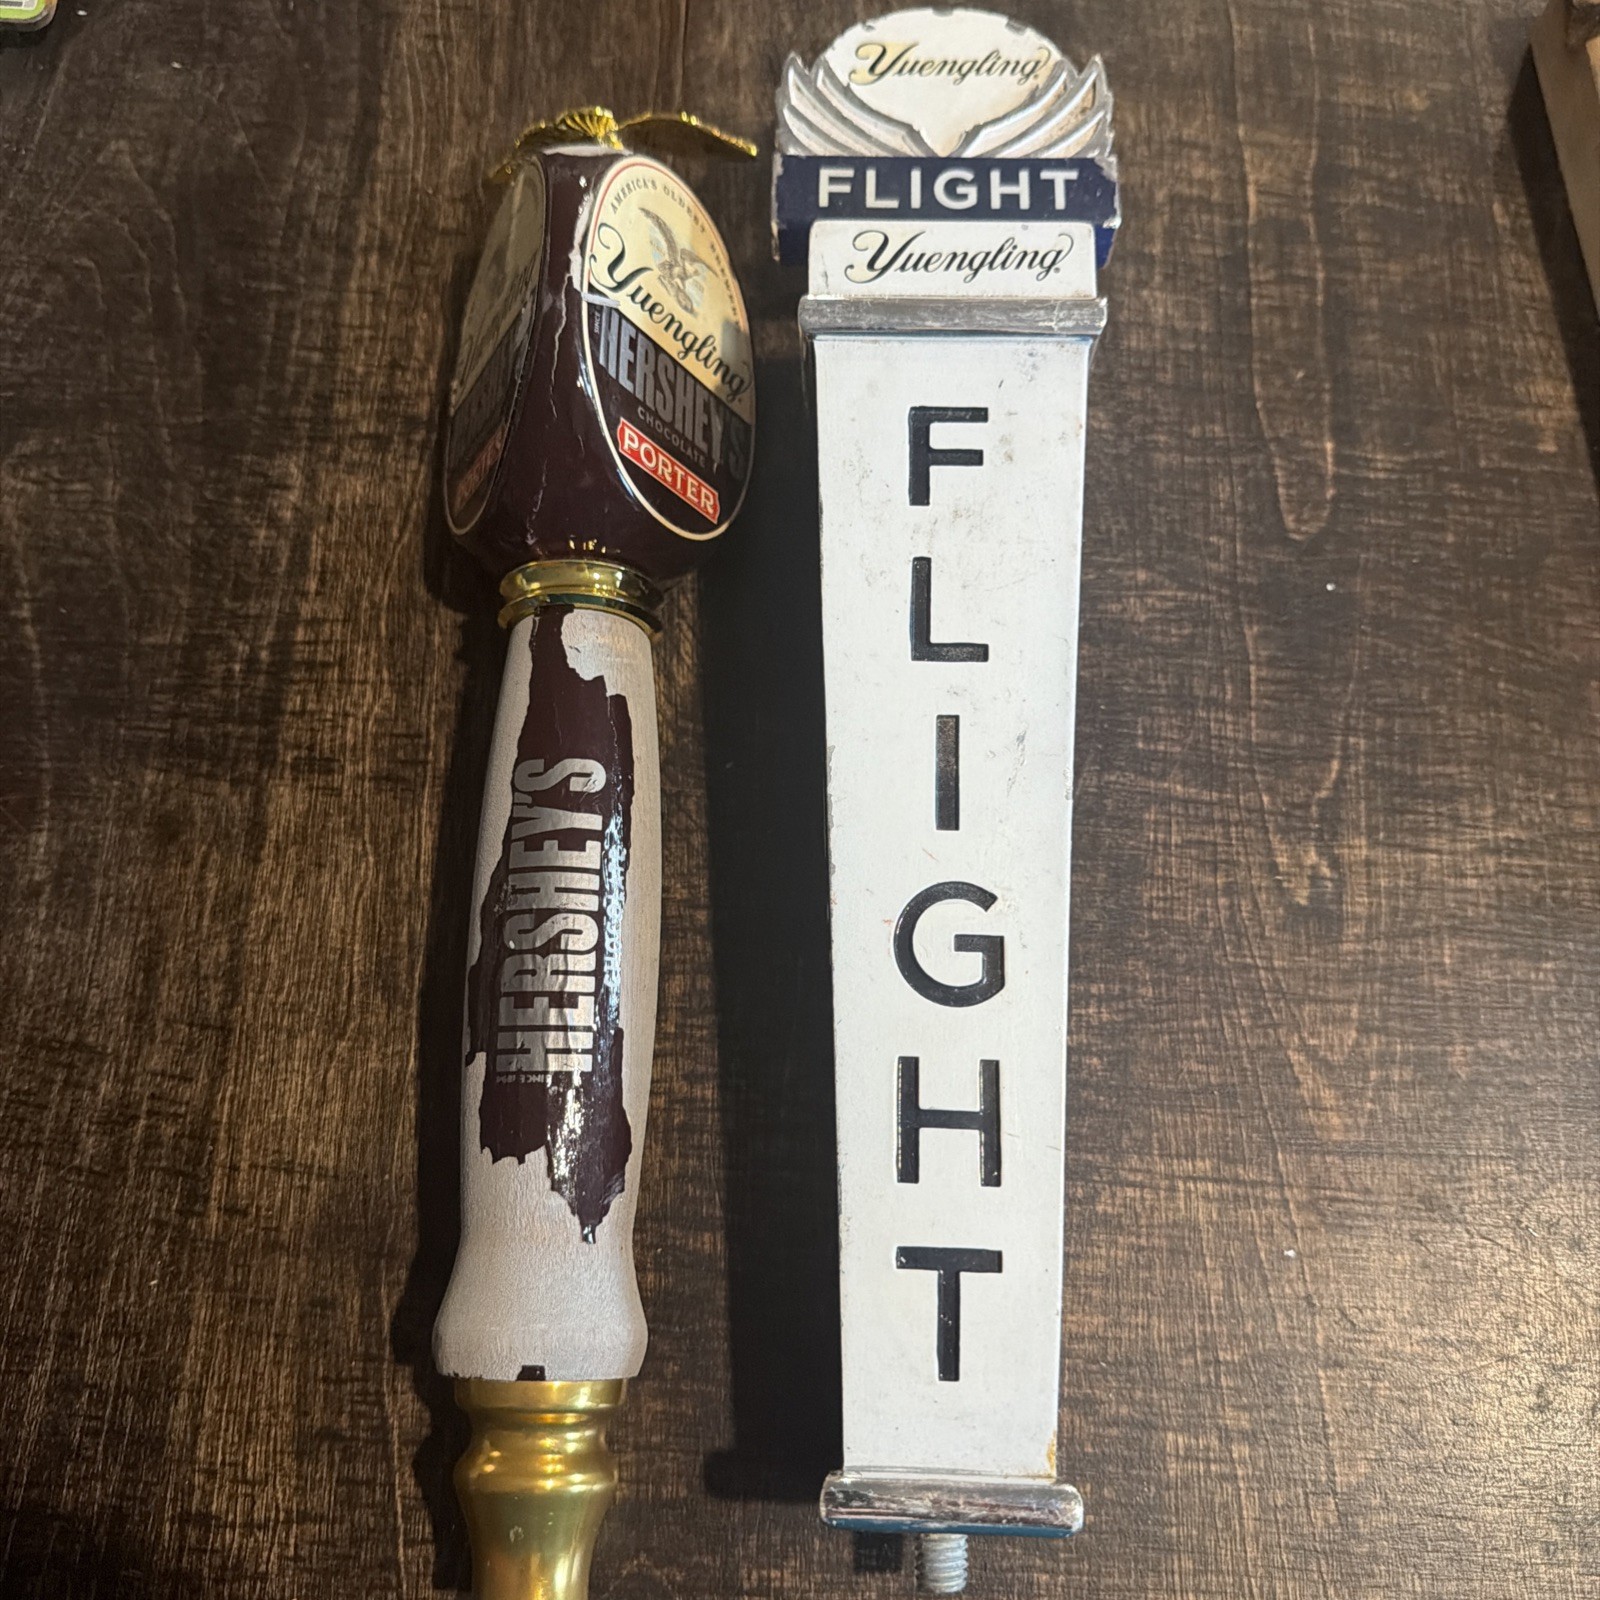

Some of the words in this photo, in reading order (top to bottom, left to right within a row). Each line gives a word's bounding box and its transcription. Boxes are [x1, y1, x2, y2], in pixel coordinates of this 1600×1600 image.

[849, 43, 1051, 86] Yuengling
[610, 177, 659, 214] AMERICA'S
[818, 167, 1080, 211] FLIGHT
[844, 229, 1074, 284] Yuengling
[589, 222, 750, 397] Yuengling
[637, 407, 706, 469] CHOCOLATE
[622, 424, 716, 516] PORTER
[495, 757, 607, 1072] HERSHEY'S
[892, 405, 1006, 1383] FLIGHT
